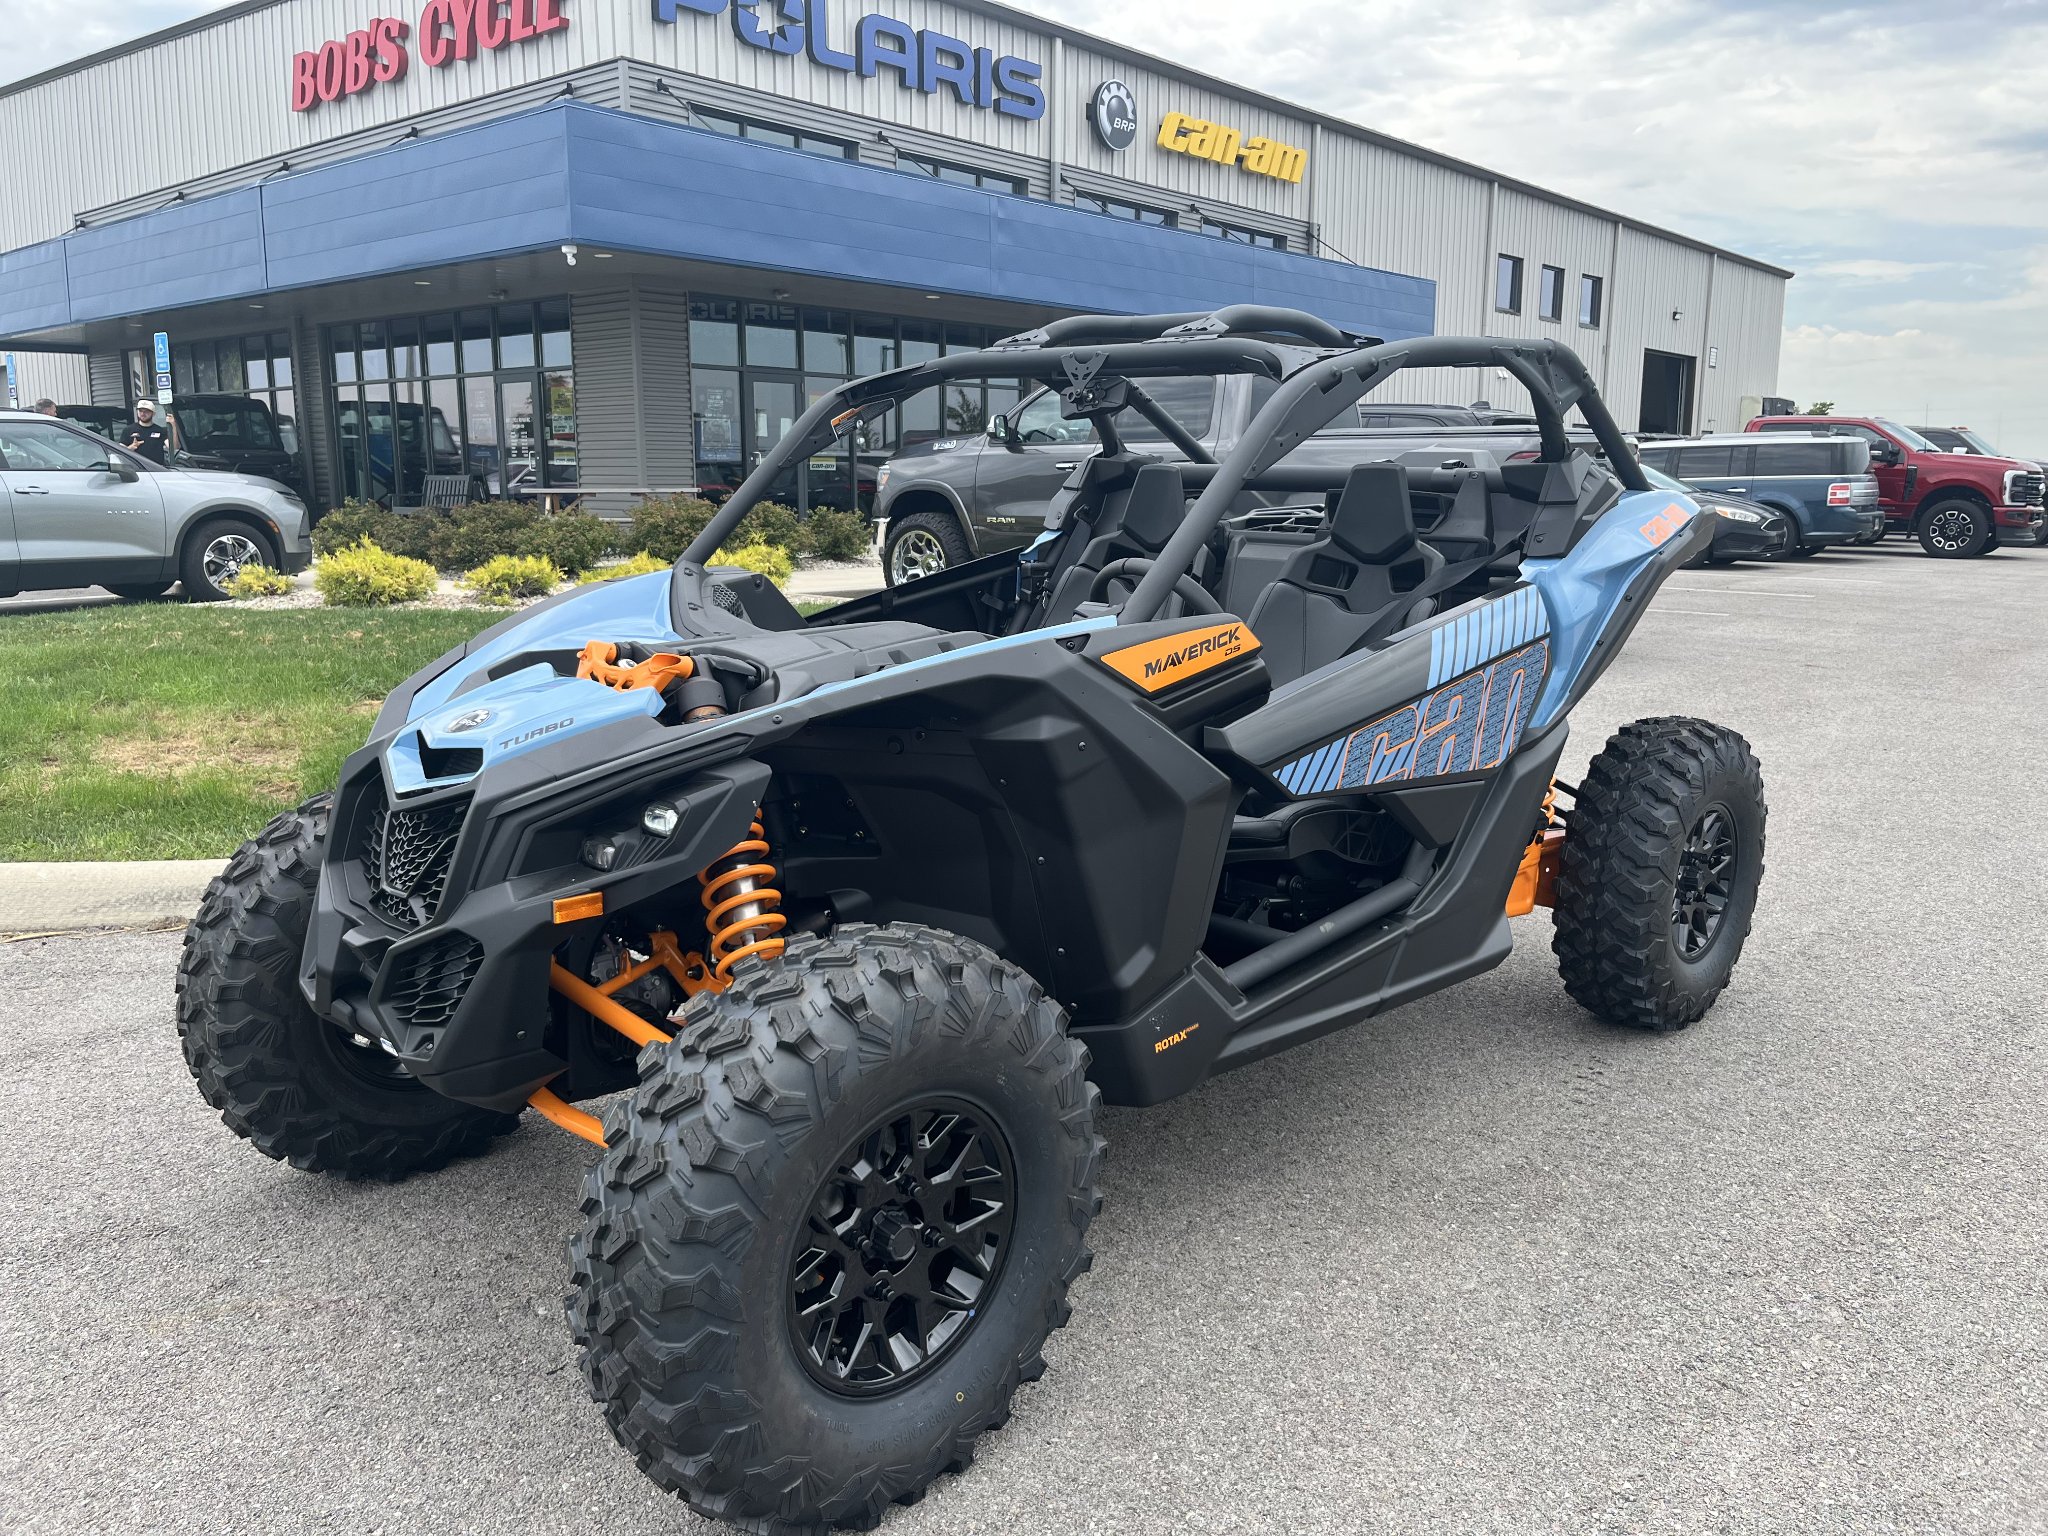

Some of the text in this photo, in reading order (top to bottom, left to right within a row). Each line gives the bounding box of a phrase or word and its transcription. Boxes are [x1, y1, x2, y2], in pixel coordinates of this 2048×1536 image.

[292, 17, 409, 112] BOB'S
[1113, 117, 1136, 133] BRP
[1157, 111, 1308, 184] can-am
[986, 516, 1016, 524] RAM
[1144, 625, 1241, 678] MAVERICK
[1224, 644, 1241, 657] DS
[498, 717, 575, 750] TURBO
[1154, 1029, 1187, 1054] ROTAX
